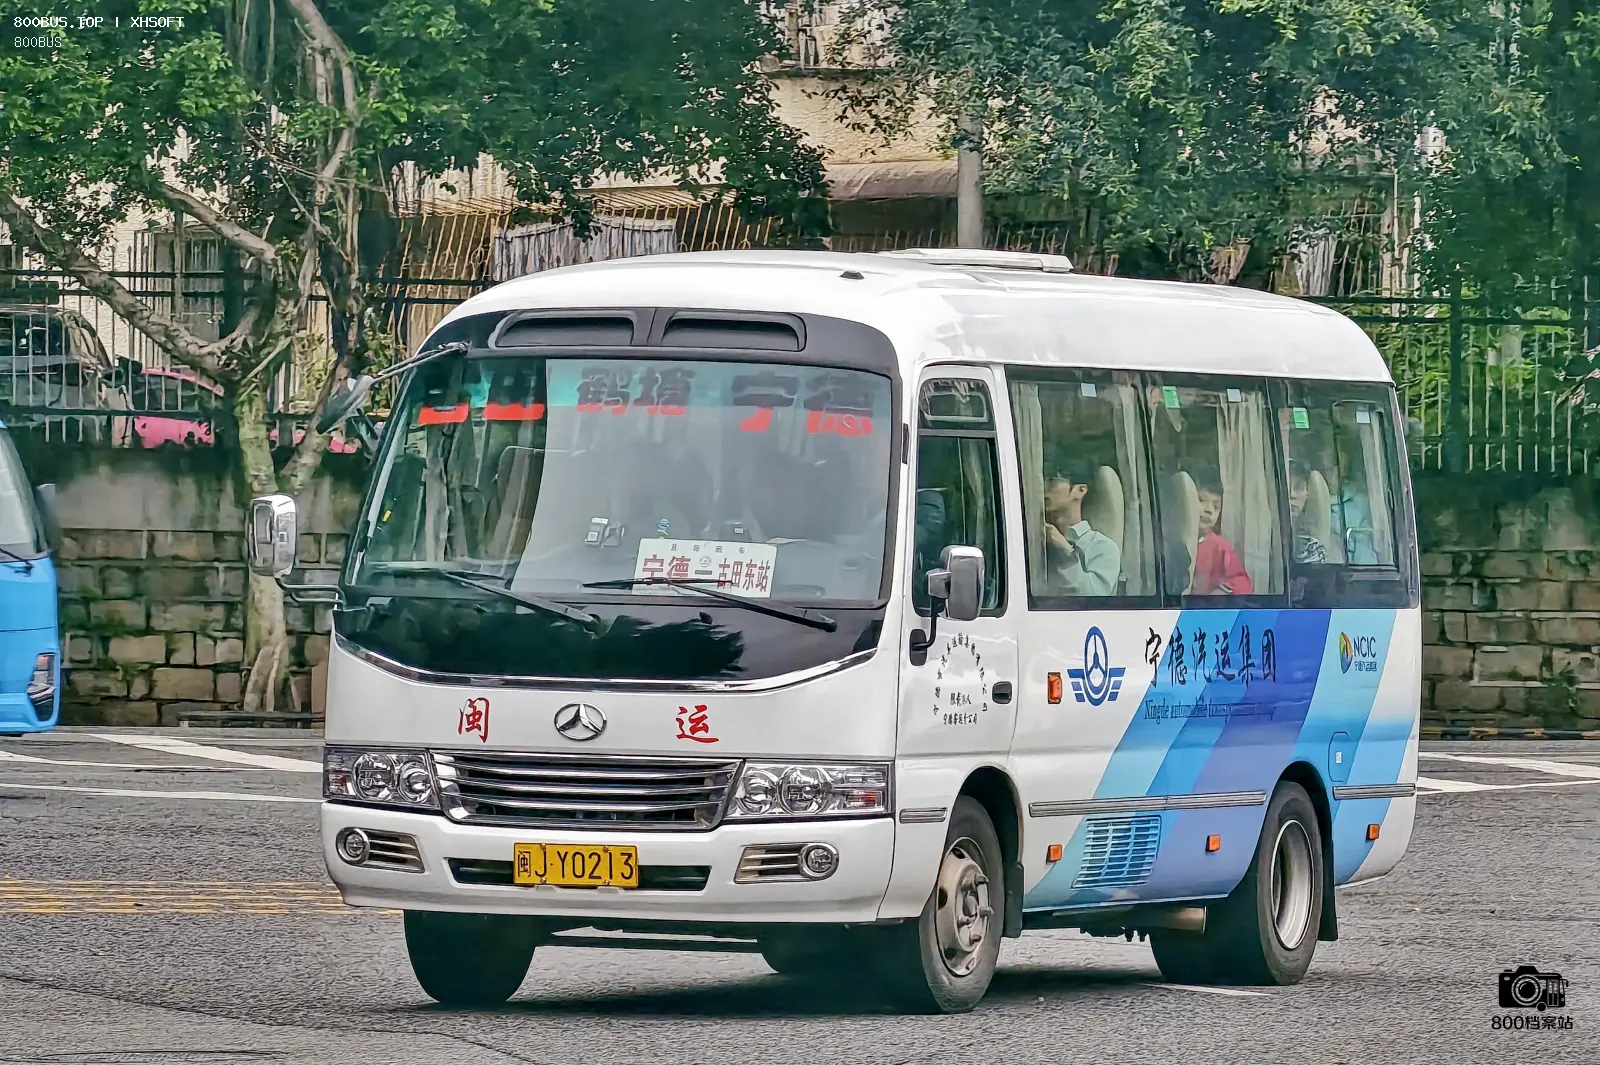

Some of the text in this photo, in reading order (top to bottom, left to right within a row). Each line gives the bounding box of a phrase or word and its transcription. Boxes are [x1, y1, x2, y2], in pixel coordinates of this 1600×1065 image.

[641, 554, 771, 592] 宁德 古田东站
[1144, 624, 1277, 689] 宁德汽运集团
[1353, 636, 1377, 658] NCIC
[458, 697, 719, 744] 闽 运
